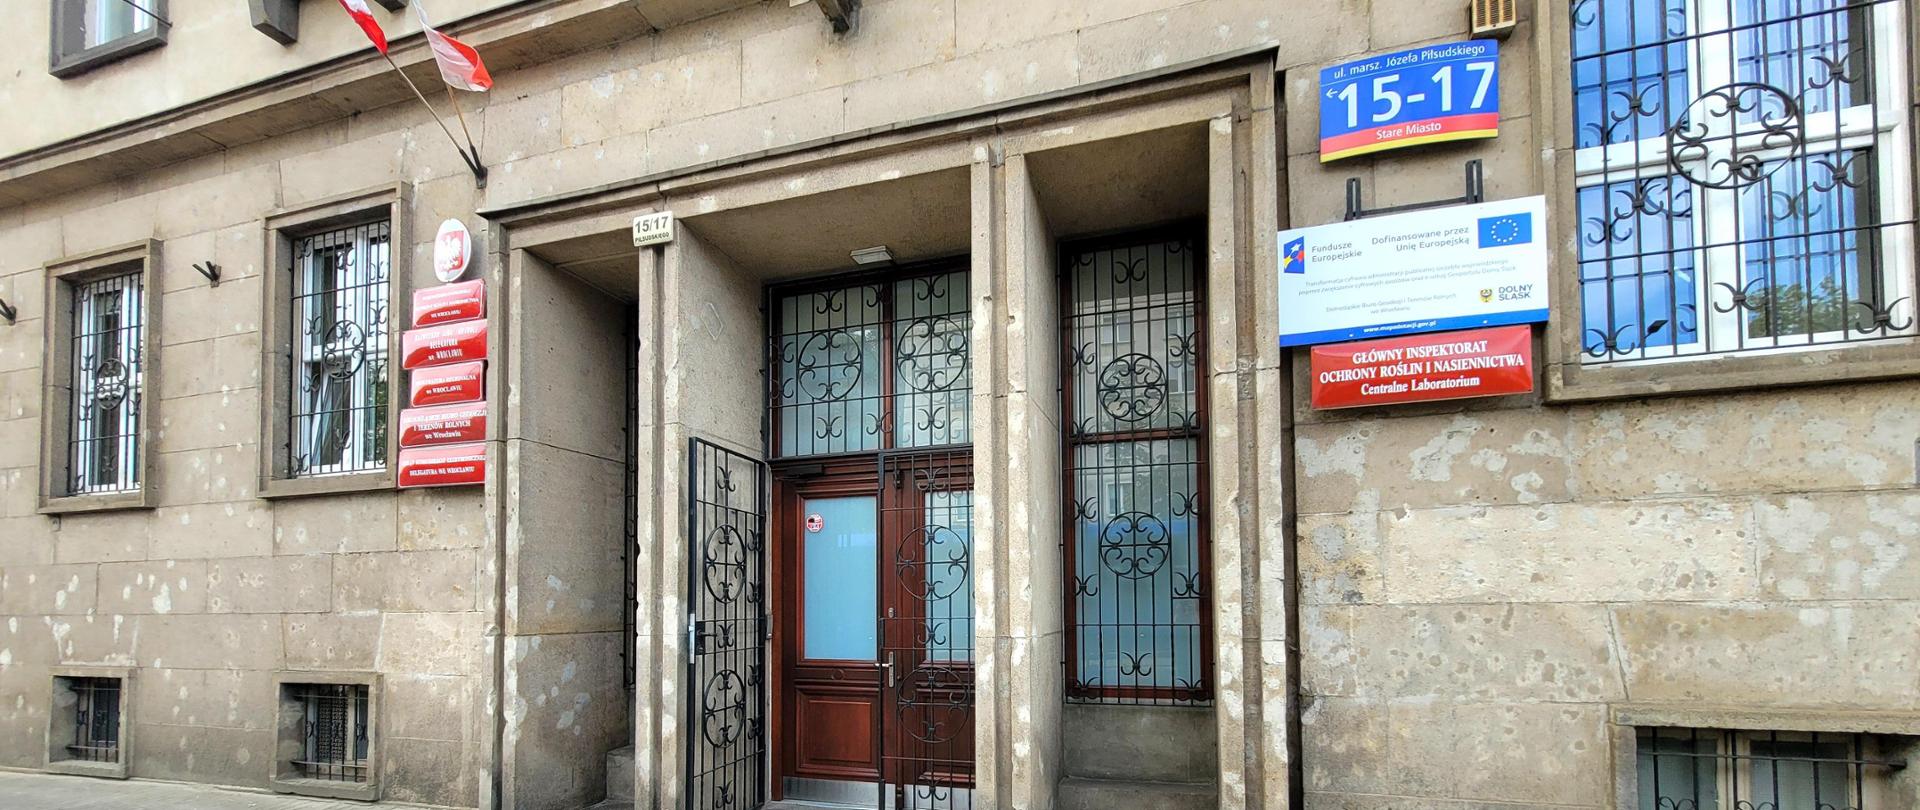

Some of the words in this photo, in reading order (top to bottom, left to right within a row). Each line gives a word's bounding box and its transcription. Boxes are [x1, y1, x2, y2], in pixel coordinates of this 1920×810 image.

[1334, 67, 1346, 79] ul.
[1350, 62, 1383, 76] marsz.
[1386, 55, 1418, 68] Józefa
[1421, 44, 1485, 61] Piłsudskiego
[1338, 61, 1495, 128] 15-17
[1376, 128, 1403, 140] Stare
[1405, 122, 1442, 135] Miasto
[635, 216, 669, 234] 15/17
[1371, 228, 1441, 245] Dofinansowane
[1444, 226, 1469, 237] przez
[1396, 242, 1417, 252] Unię
[1419, 237, 1470, 249] Europejską
[1311, 242, 1353, 253] Fundusze
[1311, 250, 1363, 262] Europejskie
[1498, 284, 1533, 294] DOLNY
[1353, 348, 1403, 365] GŁÓWNY
[1406, 340, 1488, 359] INSPEKTORAT
[1319, 366, 1378, 384] OCHRONY
[1380, 361, 1423, 378] ROŚLIN
[1425, 361, 1431, 373] I
[1434, 354, 1525, 371] NASIENNICTWA
[1361, 380, 1408, 395] Centralne
[1411, 375, 1480, 392] Laboratorium
